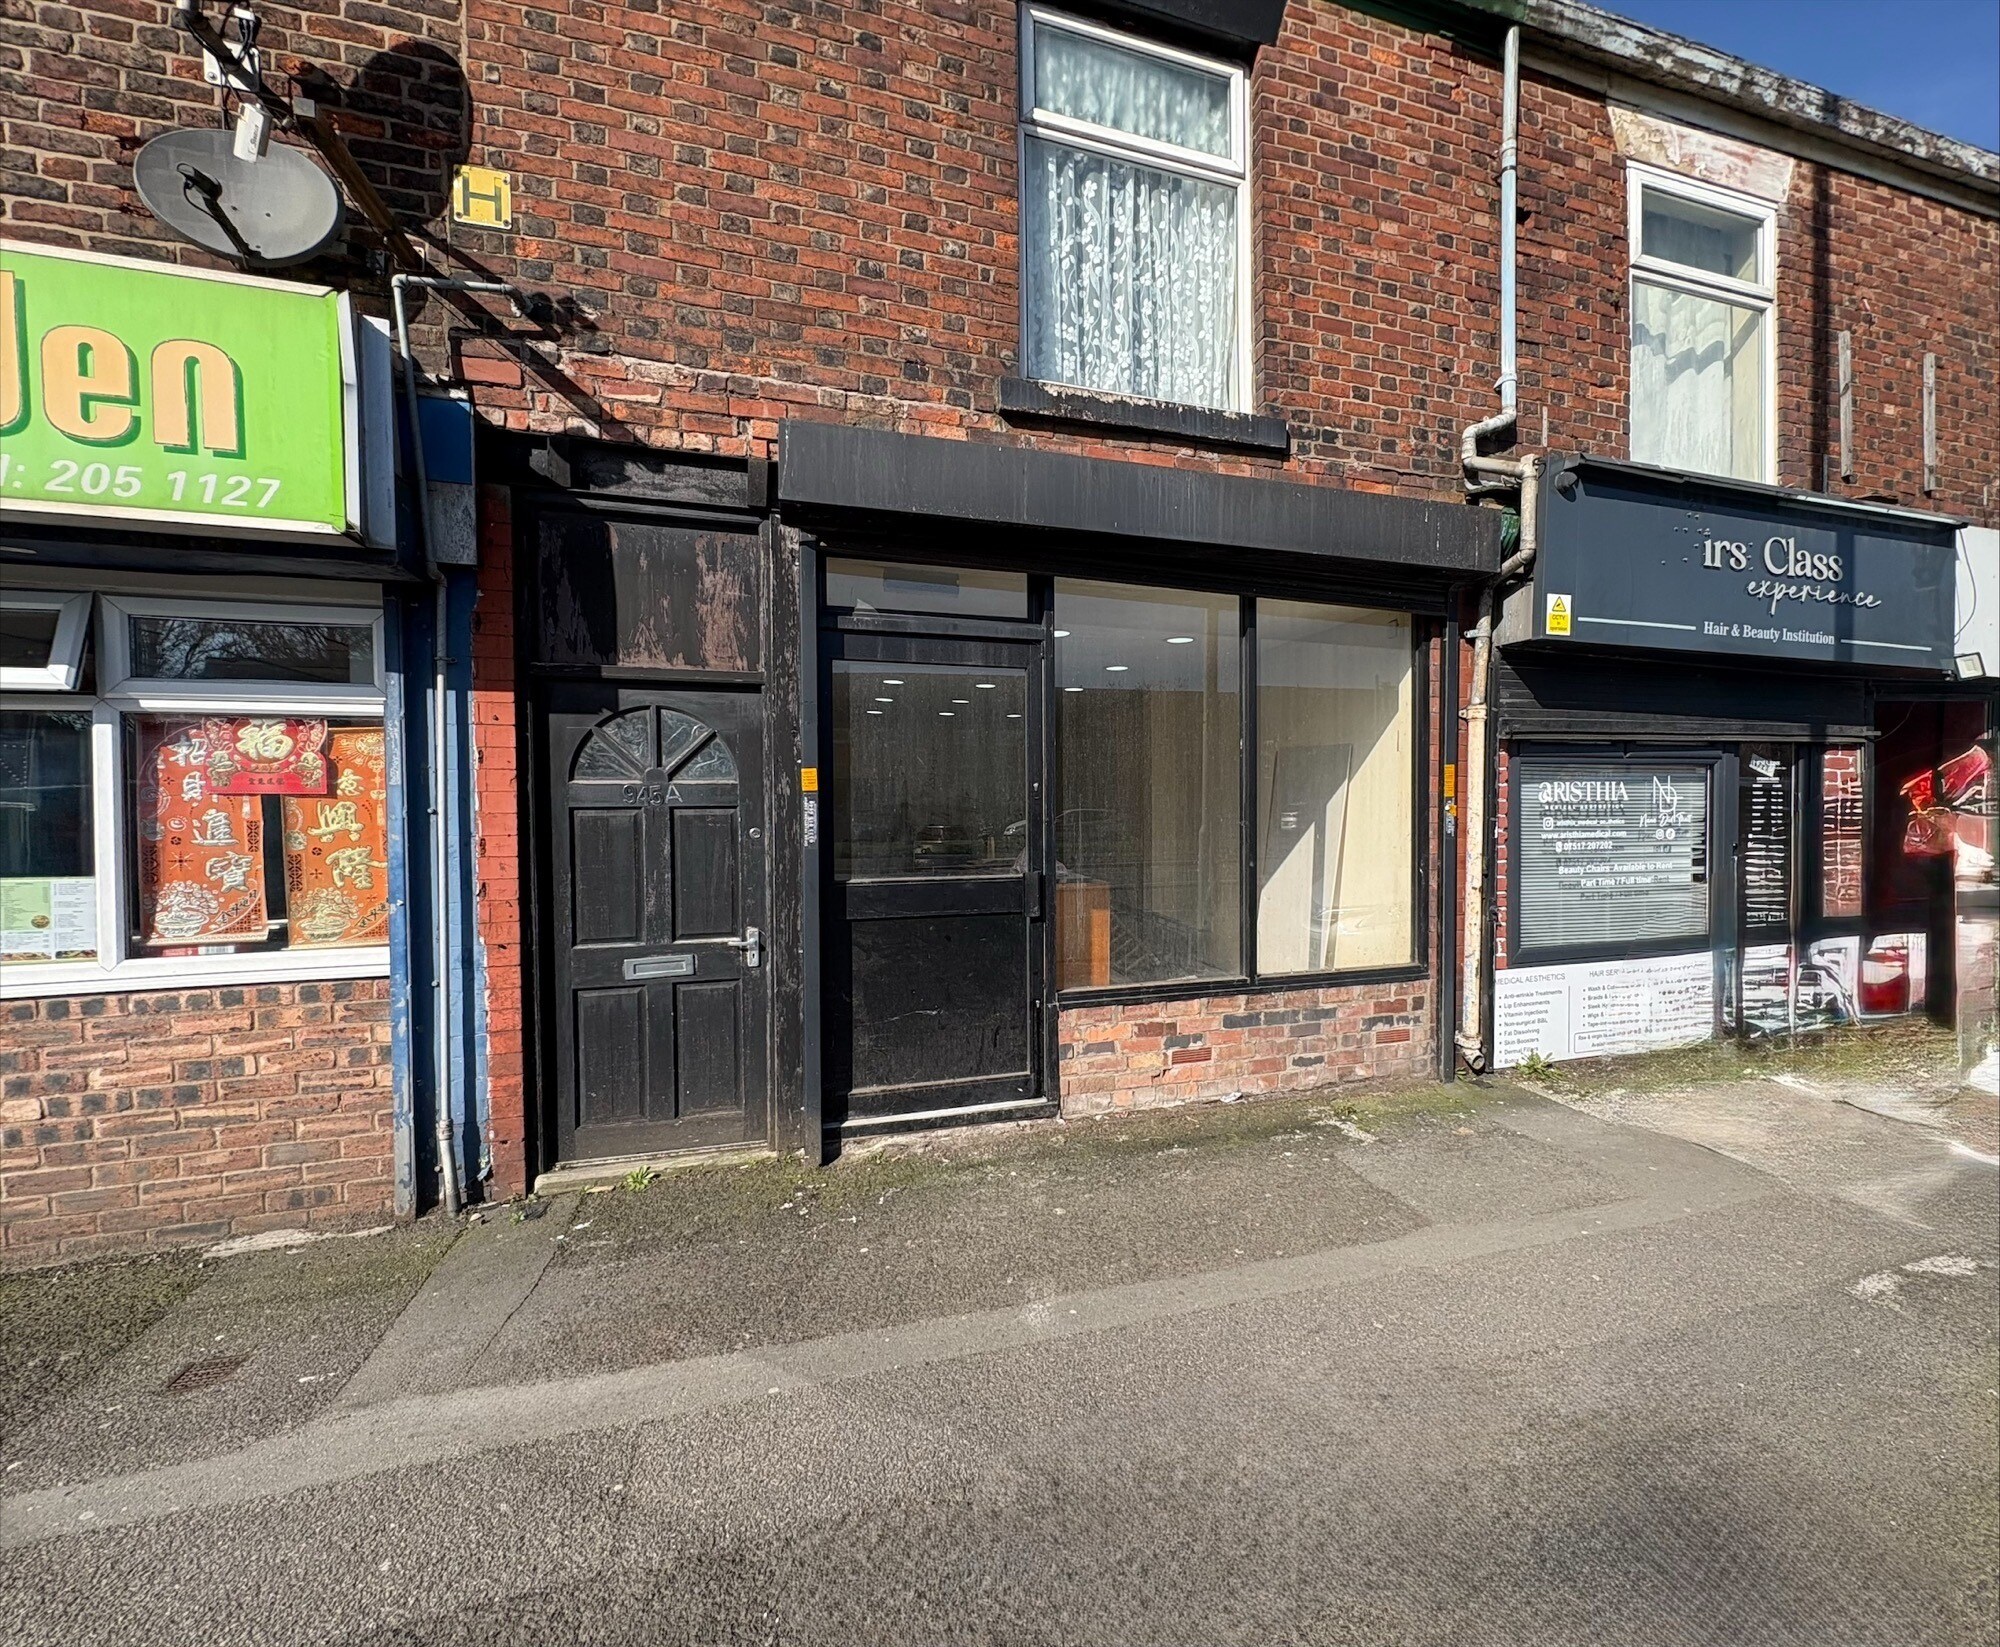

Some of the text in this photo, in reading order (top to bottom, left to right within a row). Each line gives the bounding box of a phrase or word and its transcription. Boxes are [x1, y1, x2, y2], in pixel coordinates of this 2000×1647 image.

[461, 171, 503, 223] H
[0, 270, 245, 458] en
[44, 459, 143, 498] 205
[166, 470, 281, 508] 1127
[1763, 536, 1844, 582] Class
[1747, 579, 1882, 616] experience
[1551, 613, 1567, 621] CCTV
[1703, 620, 1835, 645] Hair & Beauty Institution
[1558, 865, 1584, 876] Beauty
[1586, 864, 1611, 874] Chairs
[1613, 862, 1647, 872] Available
[1655, 861, 1673, 870] Rent
[1580, 879, 1597, 888] Part
[1597, 878, 1616, 887] Time
[1620, 876, 1636, 885] Full
[1524, 972, 1566, 984] AESTHETICS
[1503, 989, 1563, 1000] Anti-wrinkle Treatments
[1503, 999, 1551, 1010] Lip Enhancements
[1524, 1008, 1549, 1018] Injections
[1503, 1019, 1536, 1027] Non-surgical
[1513, 1027, 1541, 1037] Dissolving
[1516, 1037, 1540, 1045] Boosters
[1503, 1047, 1523, 1056] Dermal
